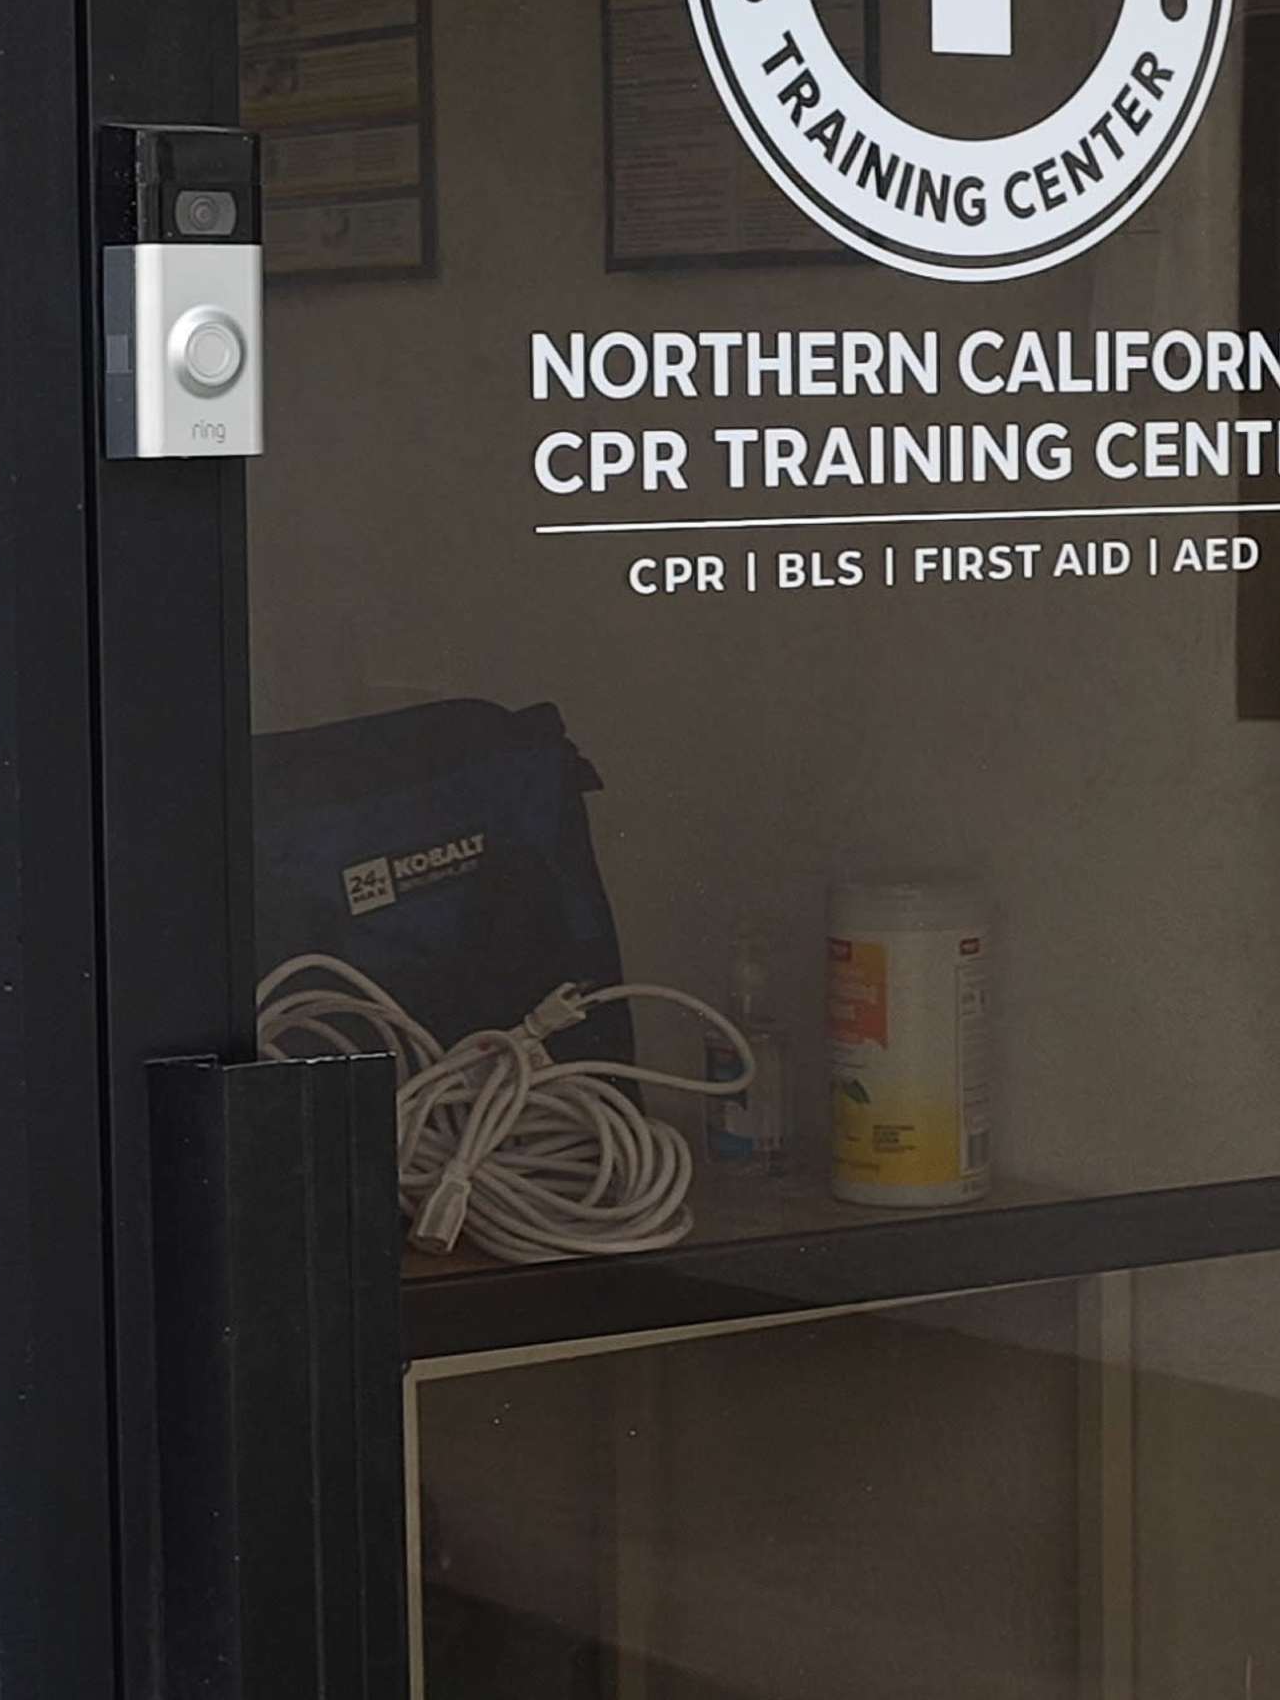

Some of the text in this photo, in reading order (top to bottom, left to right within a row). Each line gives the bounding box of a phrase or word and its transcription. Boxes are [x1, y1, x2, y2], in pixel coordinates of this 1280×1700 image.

[761, 30, 1174, 227] TRAINING CENTER
[531, 331, 938, 400] NORTHERN
[192, 420, 226, 444] ring
[534, 430, 689, 494] CPR
[714, 422, 1073, 488] TRAINING
[629, 555, 725, 595] CPR
[778, 550, 863, 589] BLS
[914, 543, 1042, 583] FIRST
[1053, 541, 1131, 577] AID
[1172, 537, 1259, 573] AED
[393, 833, 485, 878] KOBALT
